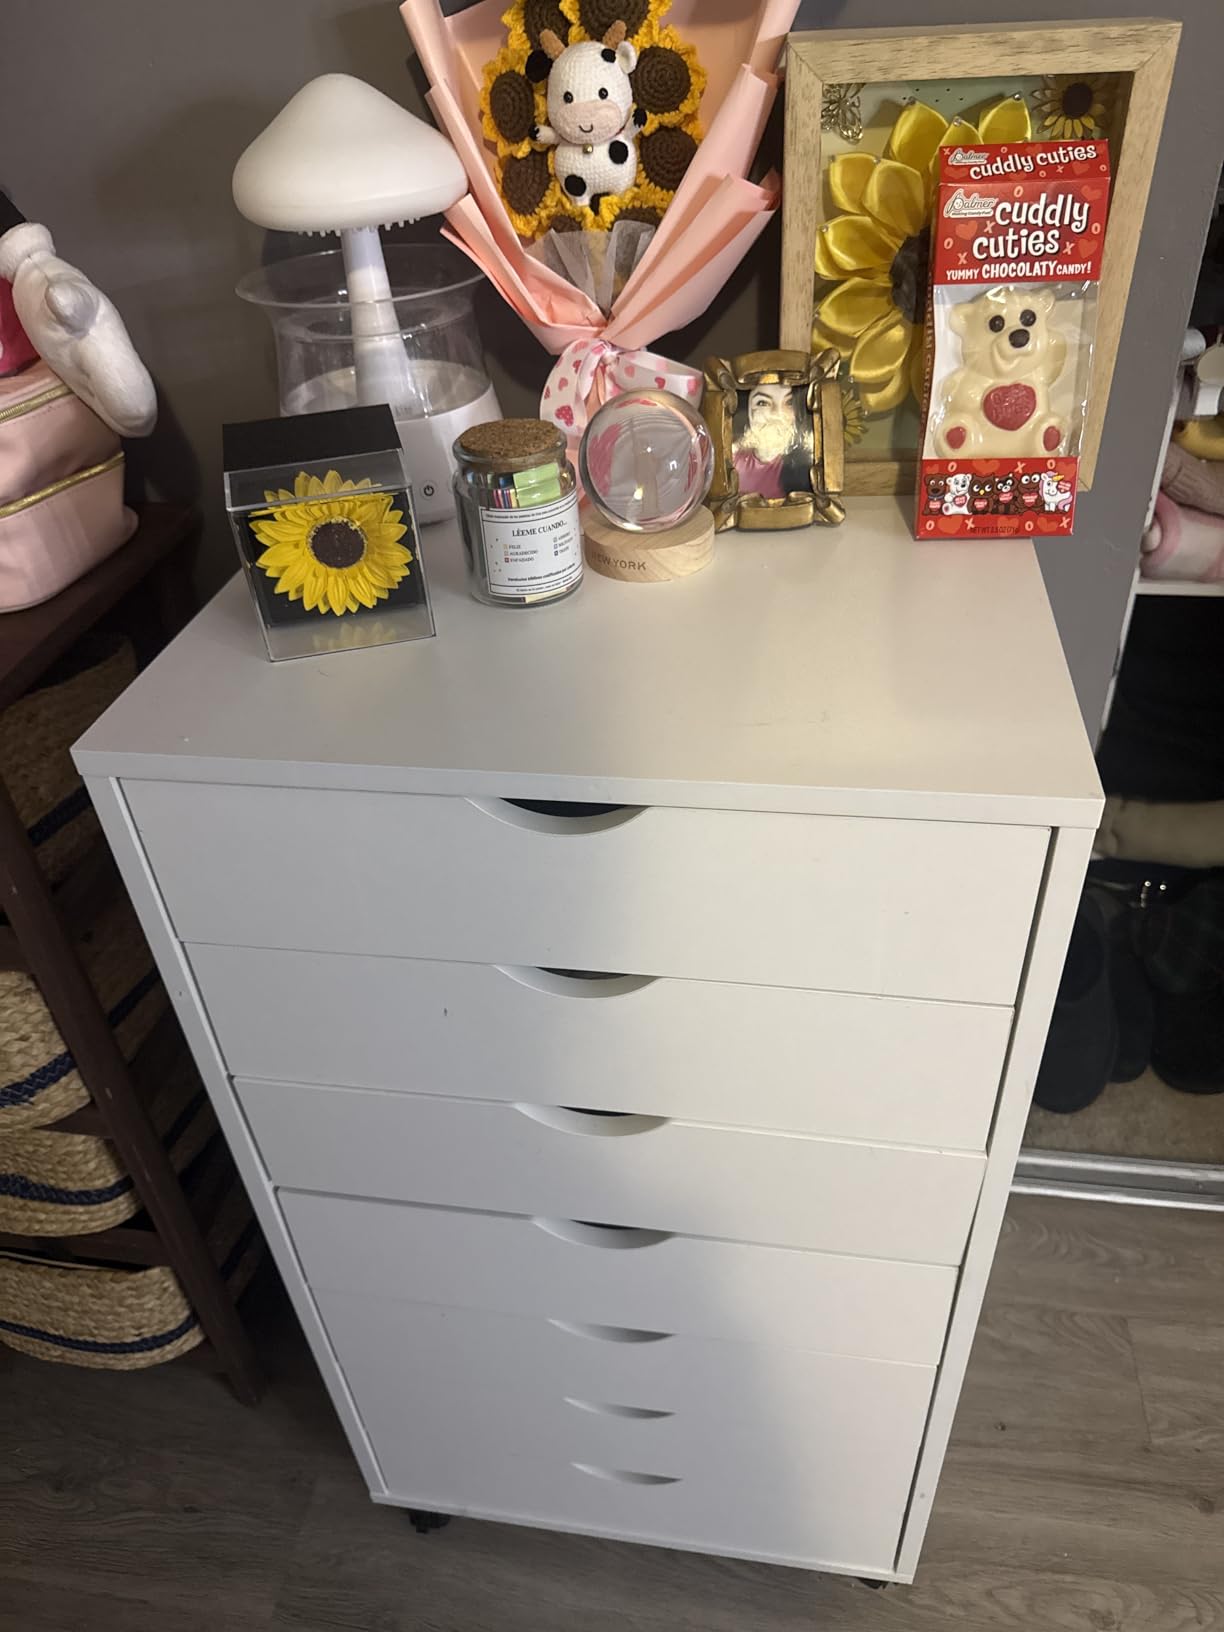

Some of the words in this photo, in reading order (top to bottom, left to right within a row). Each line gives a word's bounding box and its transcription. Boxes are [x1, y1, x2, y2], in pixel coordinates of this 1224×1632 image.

[970, 153, 1034, 180] cuddly
[1036, 145, 1097, 166] cuties
[946, 193, 994, 215] Palmer
[995, 192, 1089, 233] cuddly
[972, 227, 1060, 260] cuties
[946, 268, 979, 281] YUMMY
[982, 260, 1057, 279] CHOCOLATY
[1056, 261, 1092, 275] CANDY!
[512, 526, 538, 537] LÉEME
[613, 559, 647, 571] YORK
